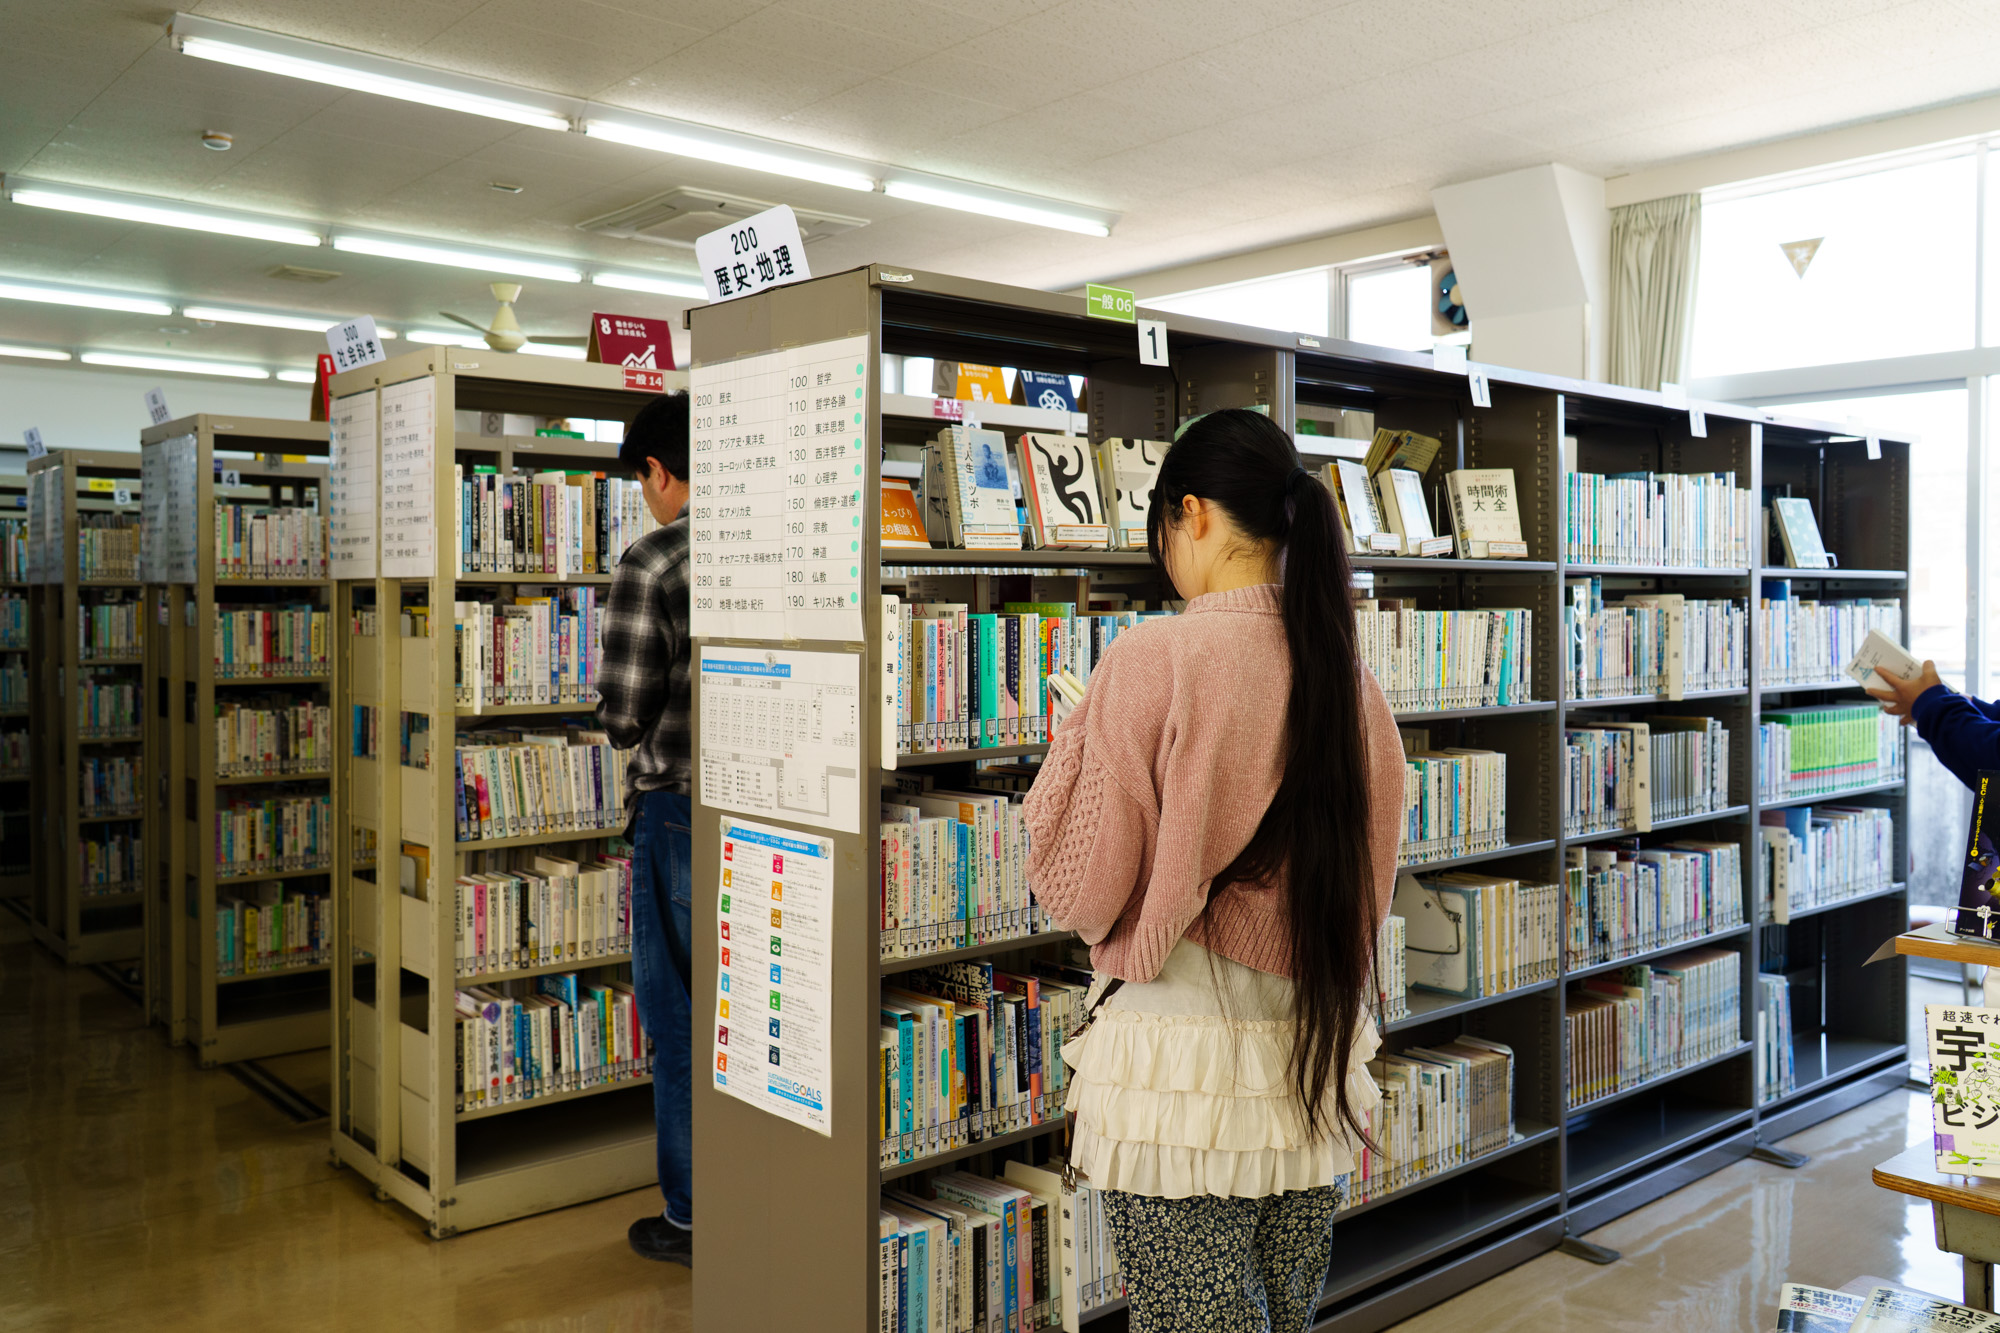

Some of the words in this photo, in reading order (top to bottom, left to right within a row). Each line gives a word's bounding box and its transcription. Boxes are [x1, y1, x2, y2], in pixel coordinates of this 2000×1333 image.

[730, 226, 758, 255] 200
[714, 245, 795, 297] 歴史・地理
[1090, 293, 1114, 311] 一般
[1116, 299, 1132, 313] 06
[600, 318, 611, 335] 8
[1147, 326, 1158, 360] 1
[625, 374, 646, 386] 一般
[649, 376, 662, 387] 14
[790, 375, 807, 388] 100
[816, 373, 832, 385] 哲学
[696, 393, 712, 406] 200
[719, 392, 732, 403] 歴史
[788, 400, 807, 413] 110
[815, 394, 846, 410] 哲学各論
[696, 416, 712, 429] 210
[719, 414, 738, 426] 日本史
[788, 425, 806, 438] 120
[815, 420, 845, 435] 東洋思想
[696, 439, 712, 451] 220
[719, 433, 765, 450] アジア史・東洋史
[788, 449, 806, 461] 130
[815, 445, 846, 459] 西洋哲学
[696, 462, 712, 474] 230
[718, 456, 776, 472] ヨーロッパ史・西洋史
[226, 473, 236, 487] 4
[788, 473, 806, 485] 140
[815, 471, 838, 484] 心理学
[964, 450, 980, 509] 人生のツボ
[118, 490, 128, 503] 5
[696, 485, 712, 497] 240
[718, 483, 746, 495] アフリカ史
[1467, 484, 1508, 498] 時間術
[787, 498, 805, 510] 150
[814, 495, 857, 509] 倫理学・道徳
[1472, 498, 1507, 512] 大全
[696, 507, 711, 519] 250
[718, 506, 751, 518] 北アメリカ史
[882, 507, 913, 519] ょっぴり
[787, 522, 804, 534] 160
[813, 521, 829, 533] 宗教
[696, 530, 712, 542] 260
[719, 529, 752, 541] 南アメリカ史
[696, 552, 712, 564] 270
[786, 547, 804, 559] 170
[812, 547, 827, 559] 神道
[697, 575, 712, 587] 280
[719, 575, 732, 587] 伝記
[786, 571, 804, 583] 180
[812, 571, 827, 583] 仏教
[697, 598, 712, 609] 290
[787, 595, 804, 607] 190
[813, 596, 845, 609] キリスト教
[886, 604, 897, 615] 140
[886, 631, 894, 706] 心理学
[1936, 1026, 1987, 1071] 宇
[792, 1081, 822, 1102] GOALS
[1949, 1320, 1973, 1330] SPAC
